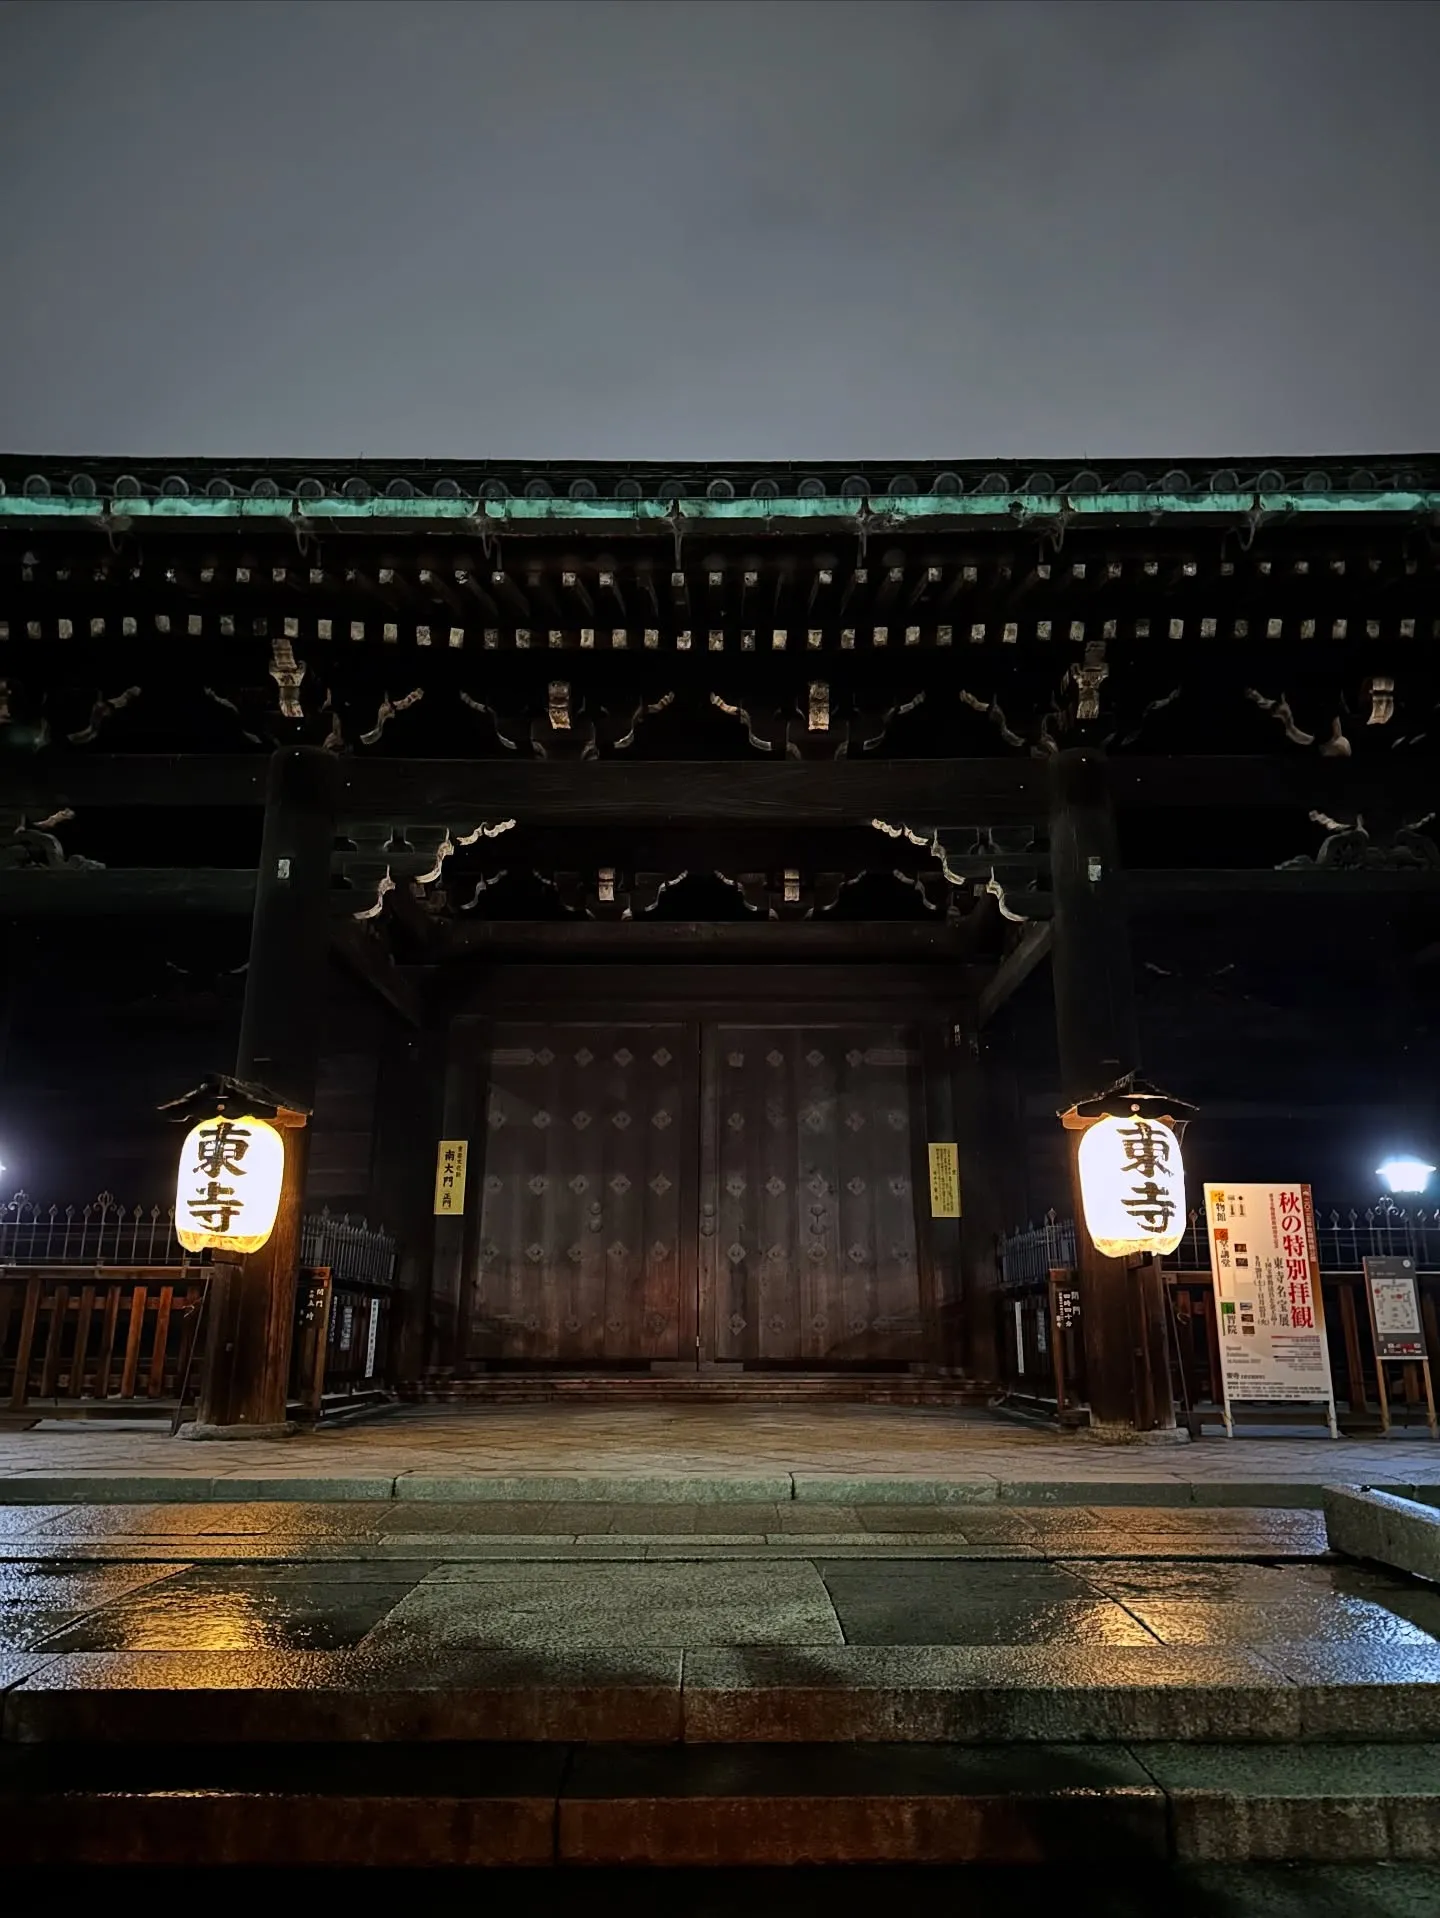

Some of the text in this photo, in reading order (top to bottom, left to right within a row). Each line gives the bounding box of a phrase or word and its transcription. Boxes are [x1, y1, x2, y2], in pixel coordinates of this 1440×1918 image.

[187, 1122, 251, 1232] 東寺
[442, 1149, 455, 1208] 南大門 正門
[1116, 1122, 1176, 1233] 東寺
[1215, 1192, 1227, 1222] 宝物館
[1274, 1256, 1290, 1327] 東寺名宝展
[1279, 1191, 1314, 1329] 秋の特別拝観
